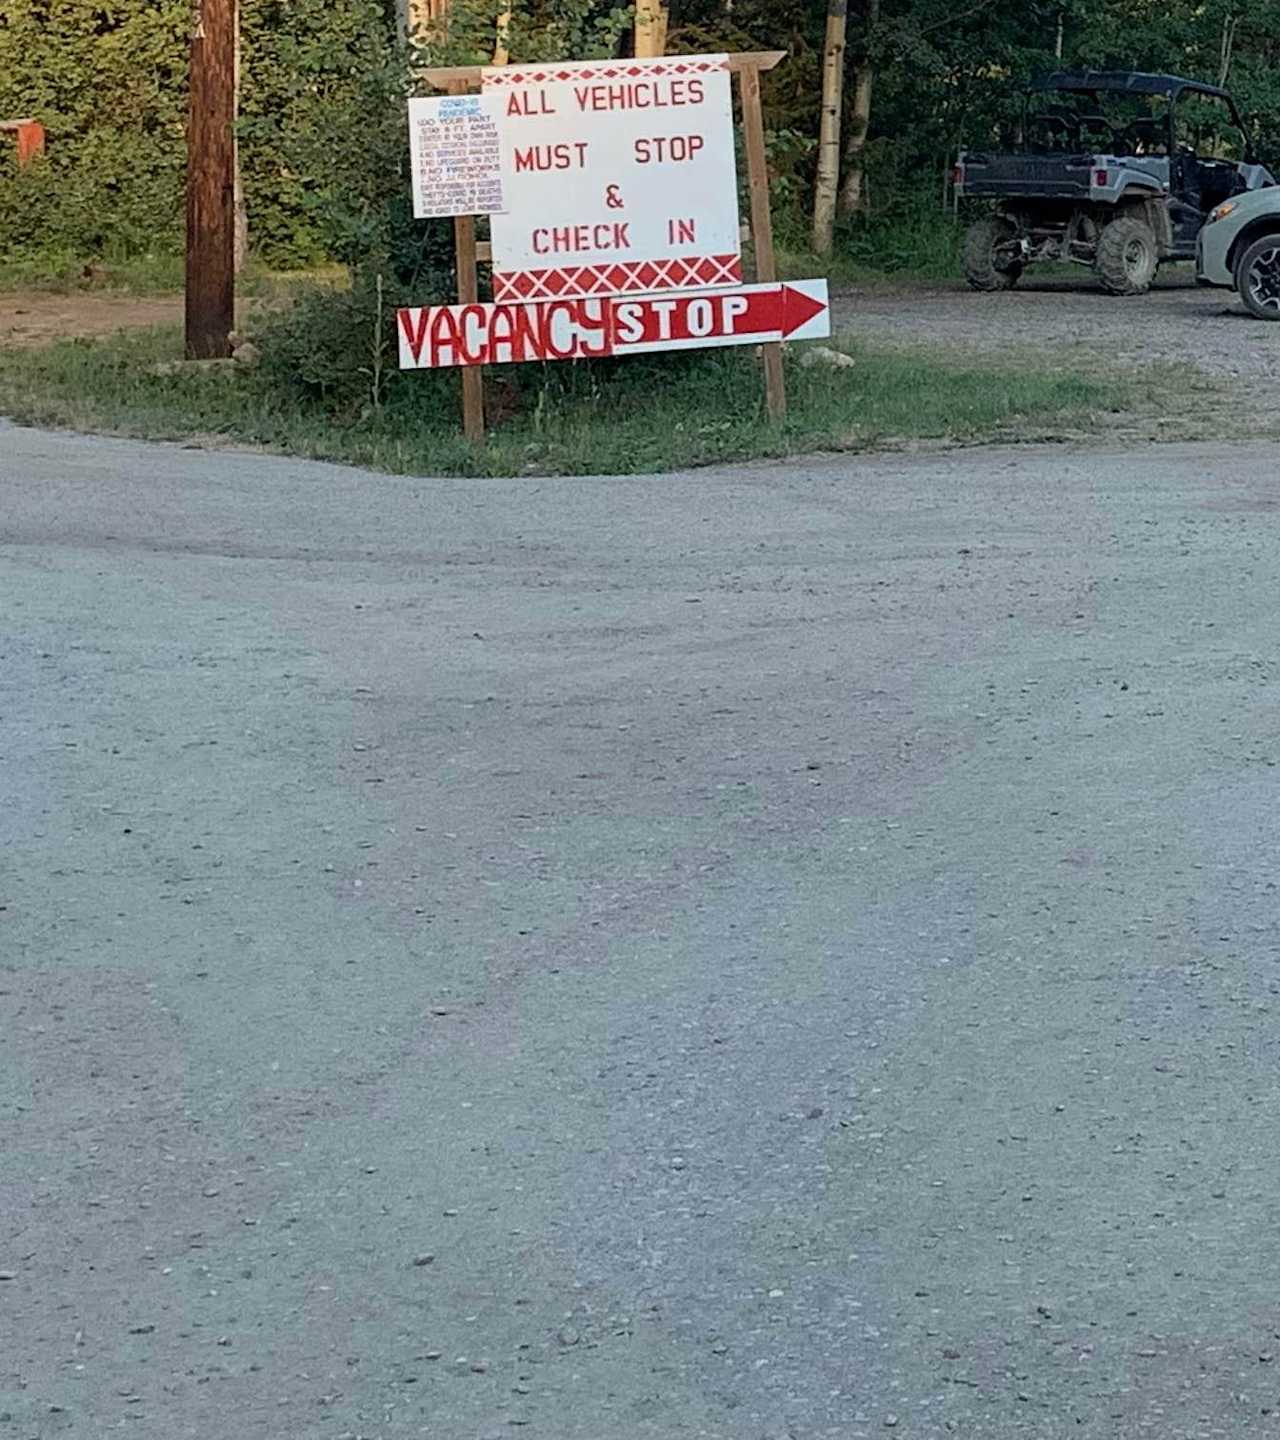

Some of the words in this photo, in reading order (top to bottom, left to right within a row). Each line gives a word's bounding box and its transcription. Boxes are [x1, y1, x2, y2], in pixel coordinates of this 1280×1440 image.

[506, 90, 556, 117] ALL
[574, 80, 704, 111] VEHICLES
[514, 143, 588, 173] MUST
[634, 135, 704, 164] STOP
[606, 184, 624, 208] &
[532, 223, 630, 254] CHECK
[668, 219, 695, 245] IN
[399, 298, 613, 367] VACANCY
[617, 295, 748, 342] STOP
